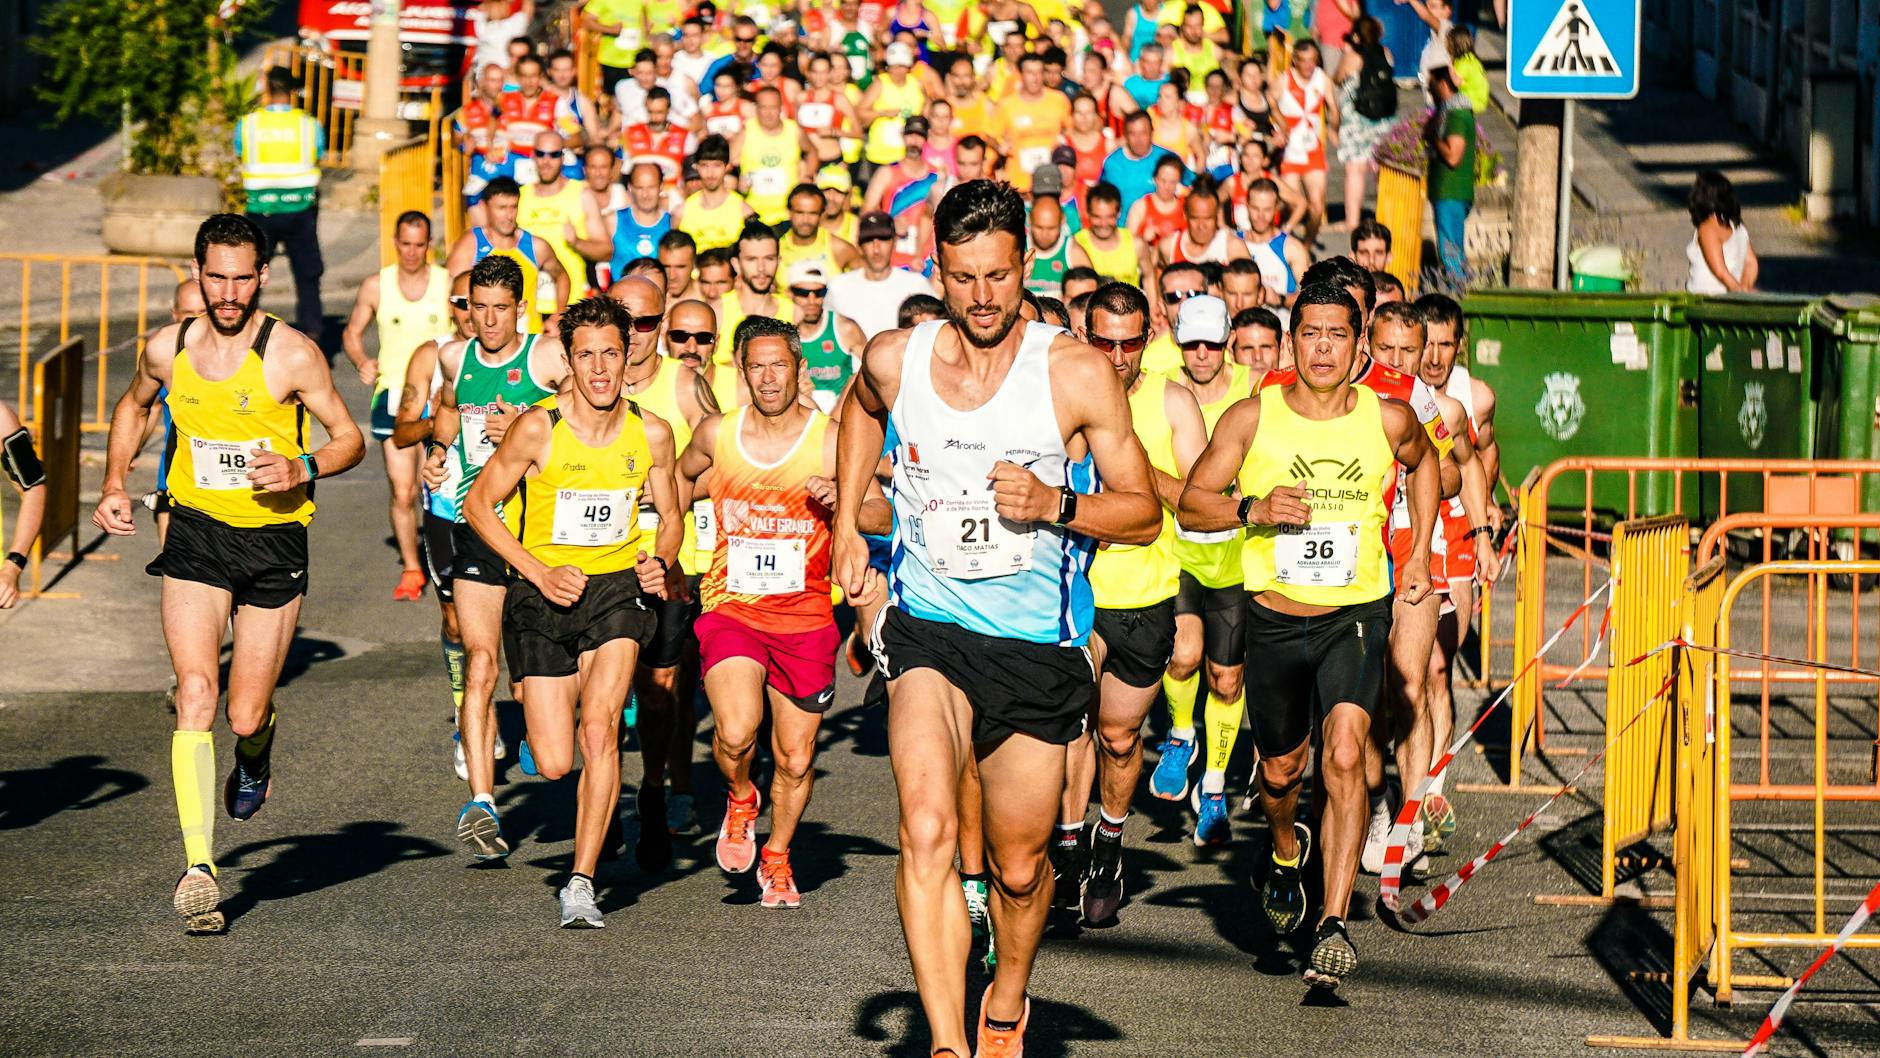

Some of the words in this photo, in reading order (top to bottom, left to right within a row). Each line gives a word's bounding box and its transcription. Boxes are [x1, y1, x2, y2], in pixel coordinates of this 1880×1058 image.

[219, 453, 246, 468] 48
[584, 505, 611, 522] 49
[750, 516, 776, 532] VALE
[776, 518, 815, 534] GRANDE
[960, 518, 990, 543] 21
[1303, 540, 1334, 560] 36
[754, 554, 776, 571] 14
